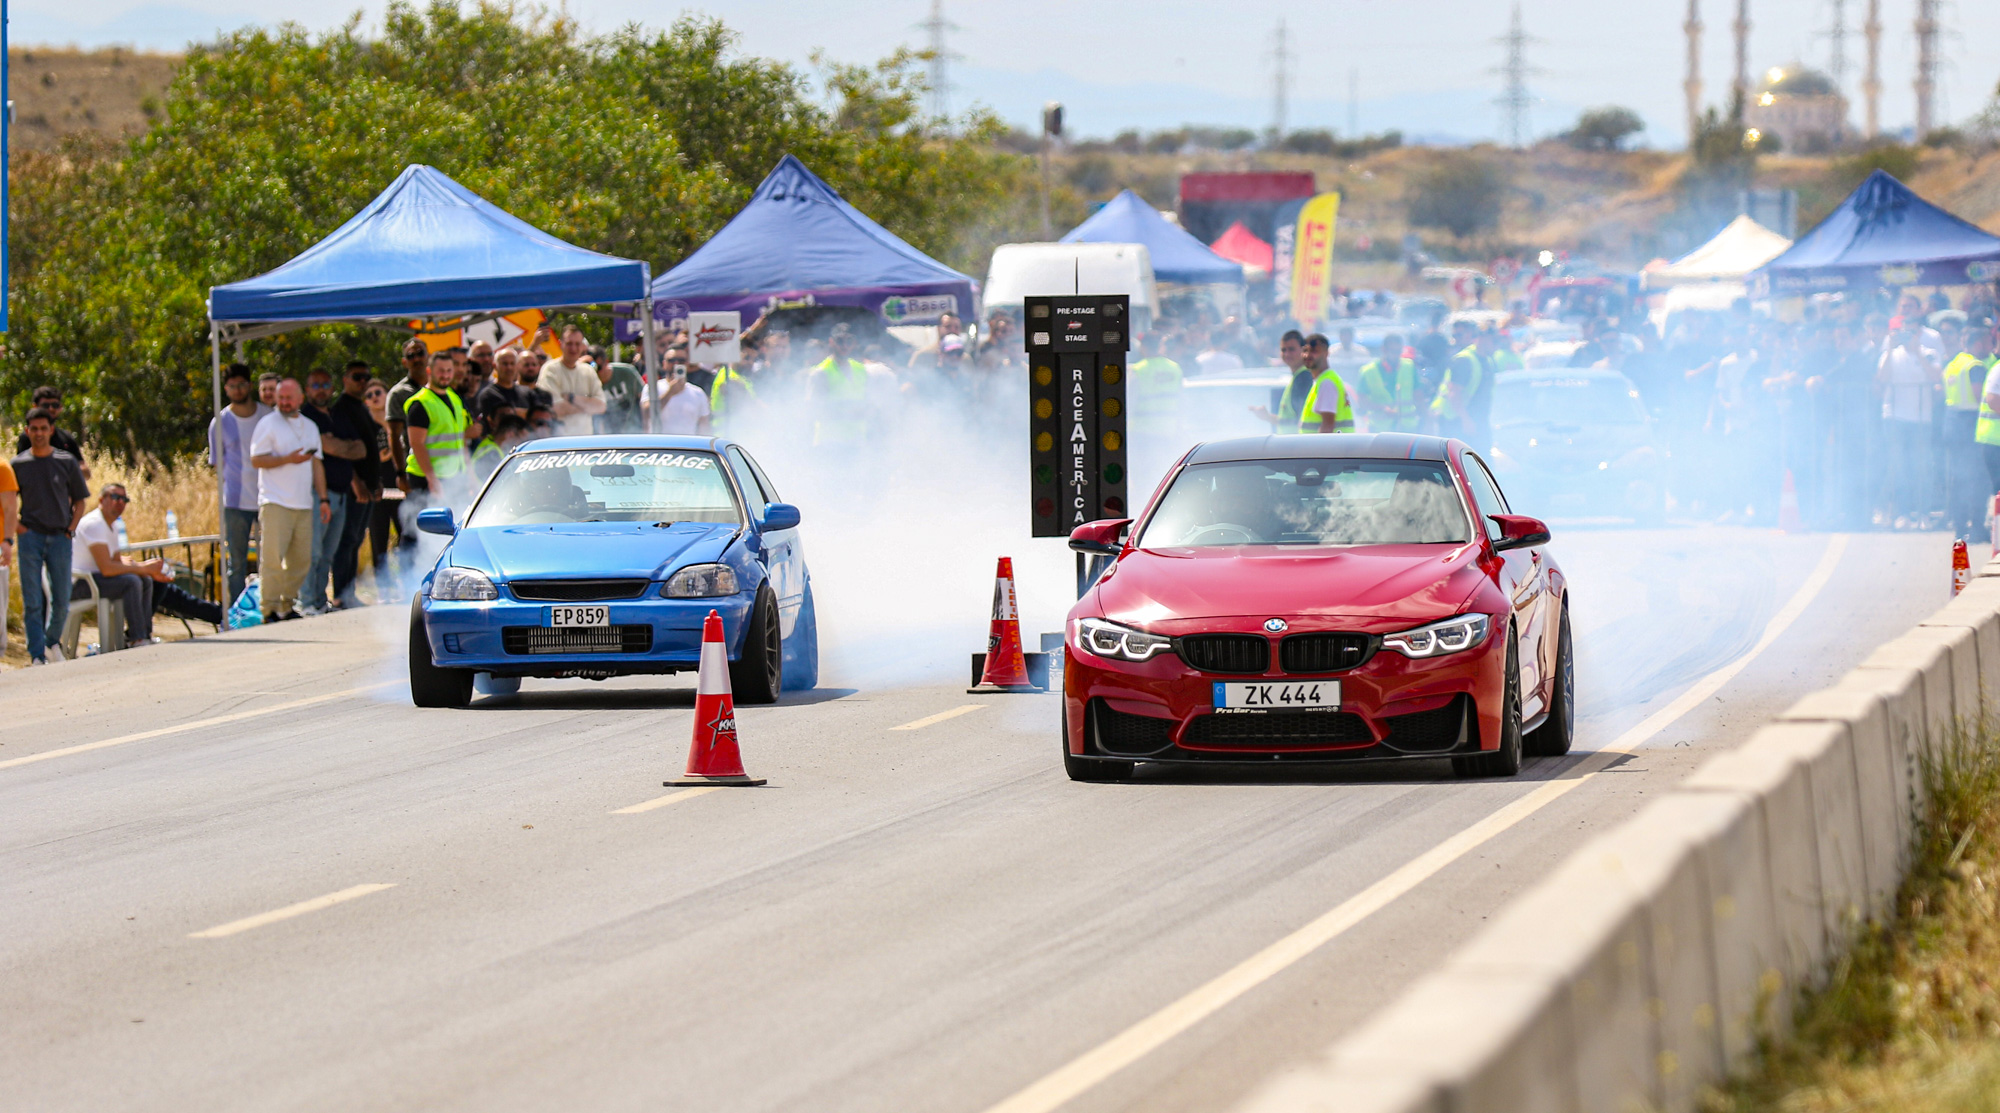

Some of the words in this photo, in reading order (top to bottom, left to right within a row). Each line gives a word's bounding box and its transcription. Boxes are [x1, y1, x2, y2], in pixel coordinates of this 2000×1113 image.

[908, 297, 952, 313] Basel
[514, 450, 629, 474] BÜRÜNCÜK
[628, 452, 714, 470] GARAGE
[553, 608, 573, 625] EP
[576, 608, 605, 625] 859
[1244, 685, 1274, 705] ZK
[1279, 684, 1322, 704] 444
